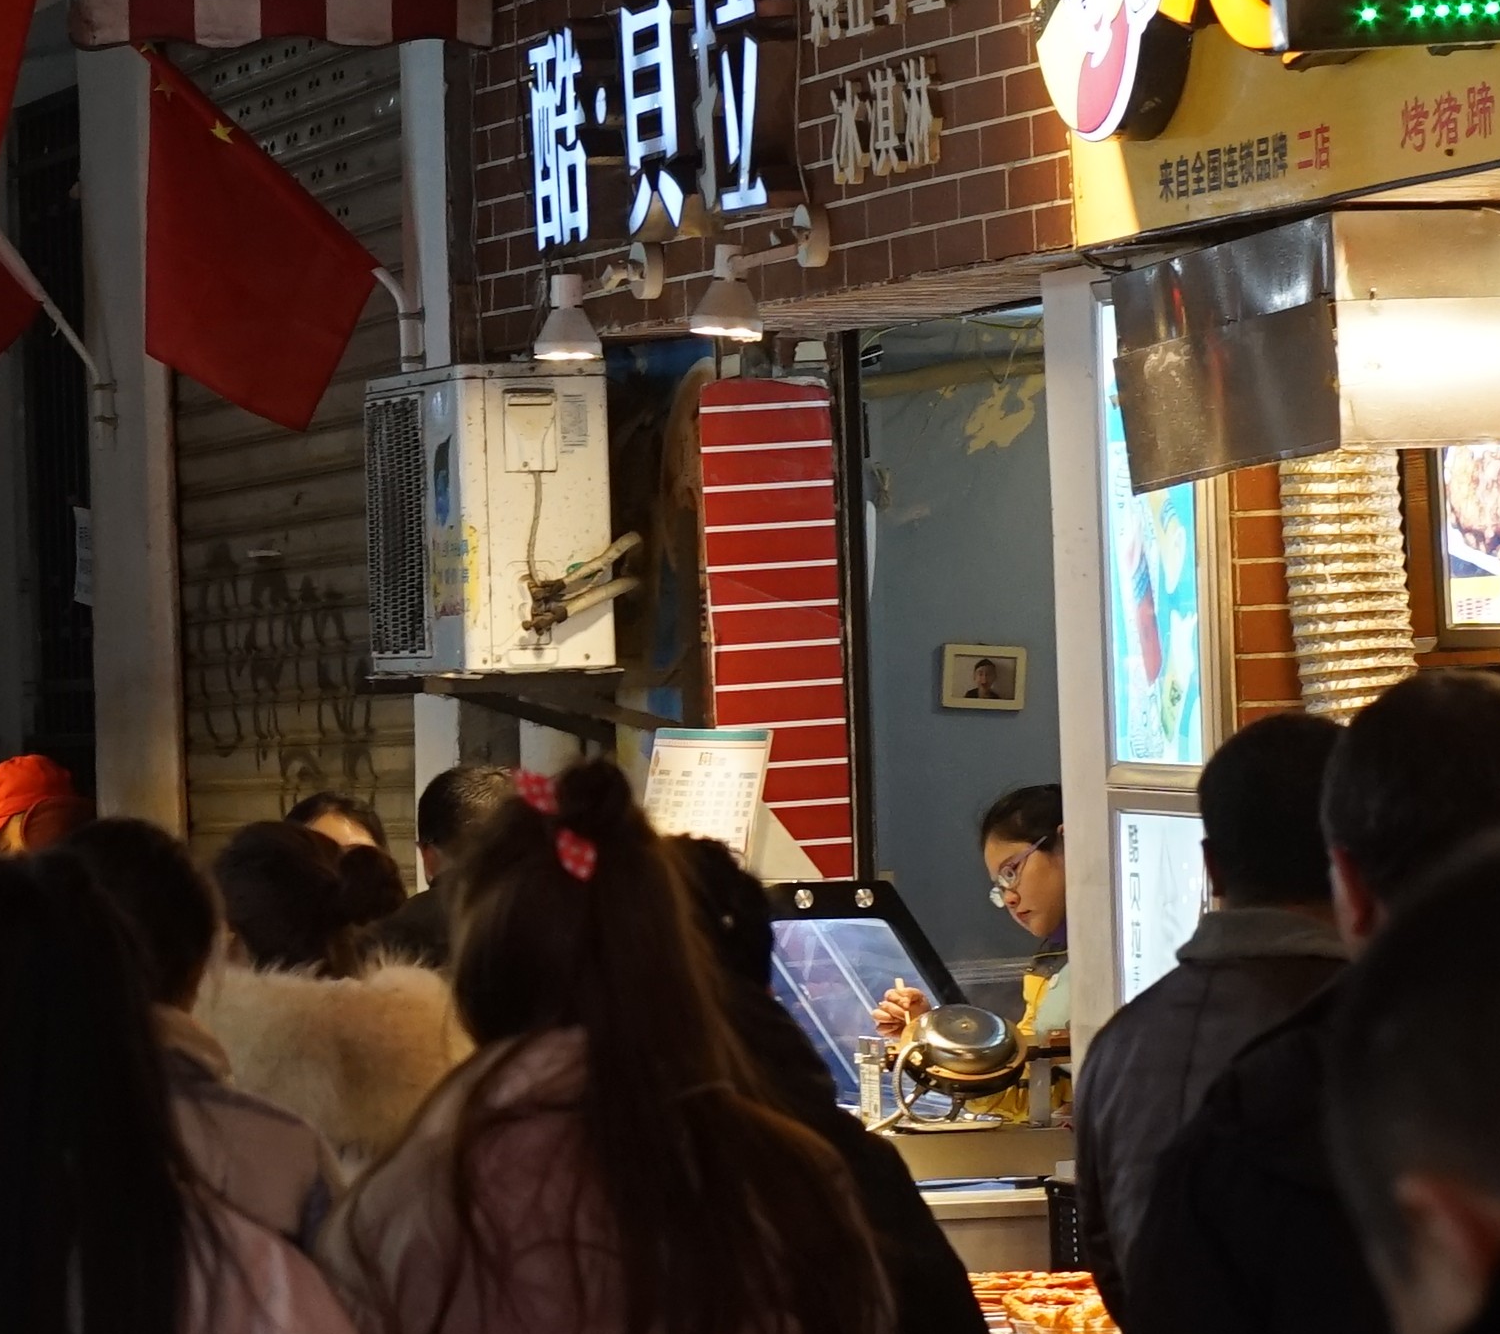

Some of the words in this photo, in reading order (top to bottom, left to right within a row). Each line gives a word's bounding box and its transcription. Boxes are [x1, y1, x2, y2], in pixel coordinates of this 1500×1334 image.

[1400, 80, 1496, 154] 烤猪蹄
[1158, 131, 1289, 203] 来自全国连锁品牌
[1297, 123, 1332, 172] 二店
